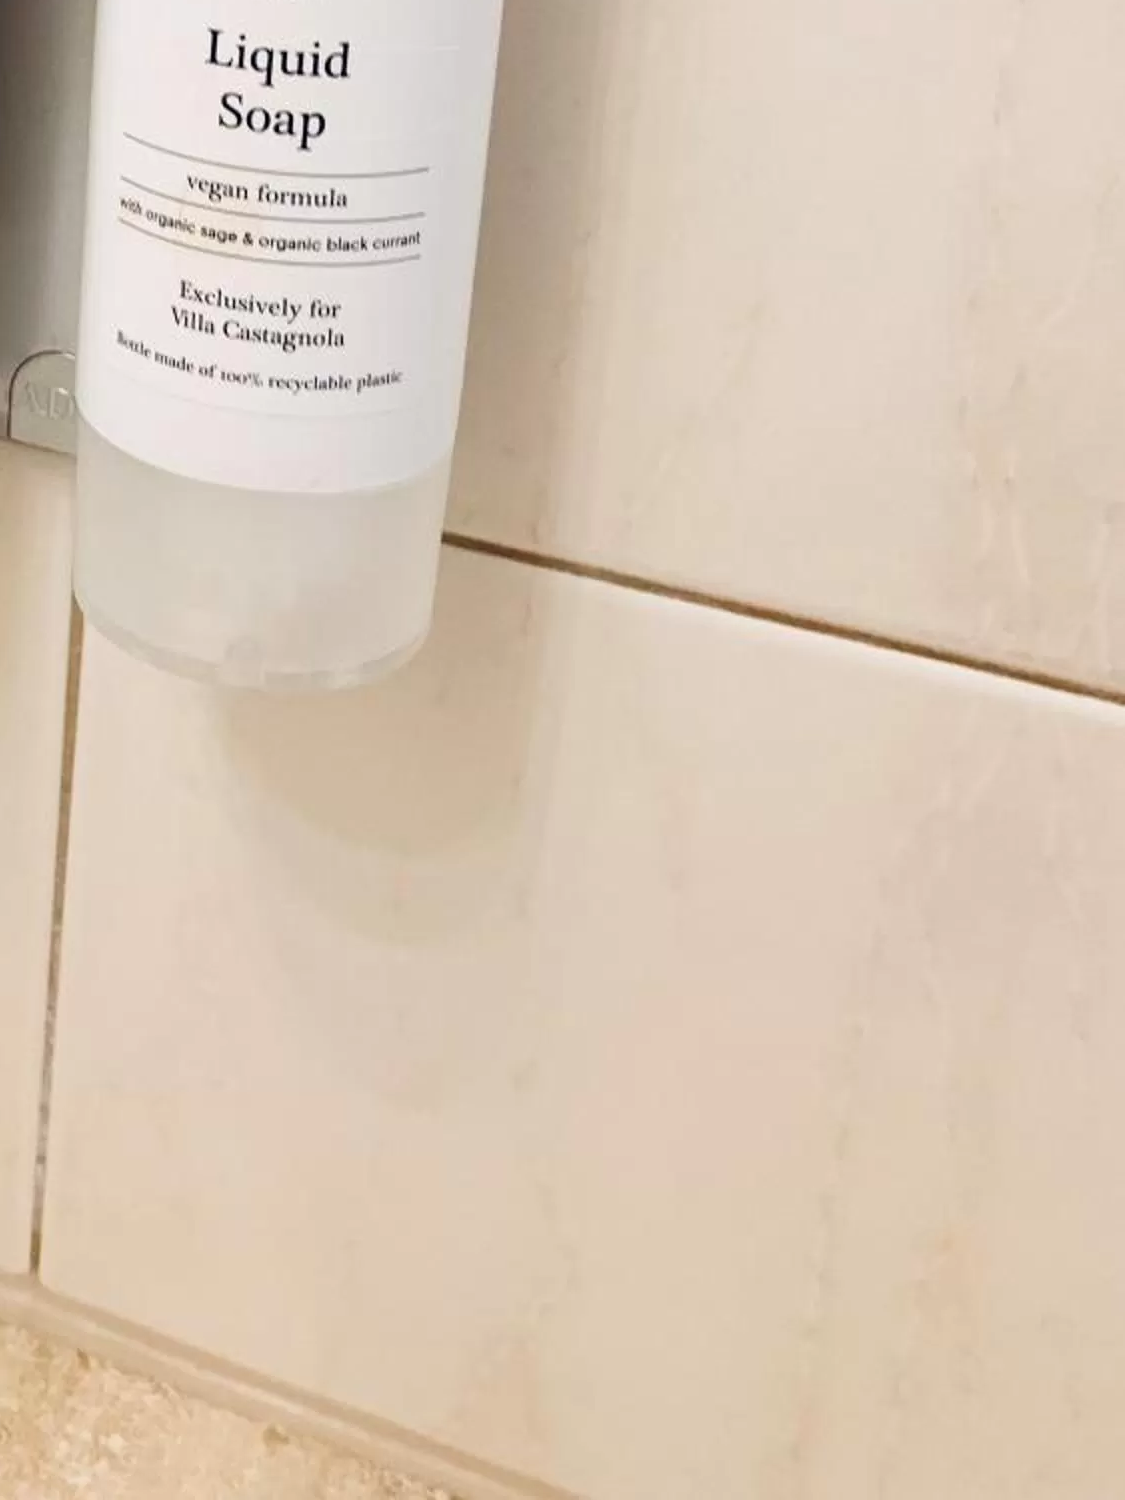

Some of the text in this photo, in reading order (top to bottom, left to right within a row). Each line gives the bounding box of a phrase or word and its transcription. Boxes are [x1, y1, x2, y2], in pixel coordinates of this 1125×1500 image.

[205, 26, 351, 88] Liquid
[218, 91, 327, 152] Soap
[187, 175, 348, 209] vegan formula
[119, 197, 421, 253] with organic sage & organic black currant
[179, 279, 342, 325] Exclusively for
[171, 305, 346, 352] Villa Castagnola
[154, 349, 195, 374] made
[198, 363, 218, 378] of
[220, 368, 264, 388] 100%
[268, 375, 353, 396] recyclable
[356, 369, 404, 393] plastic
